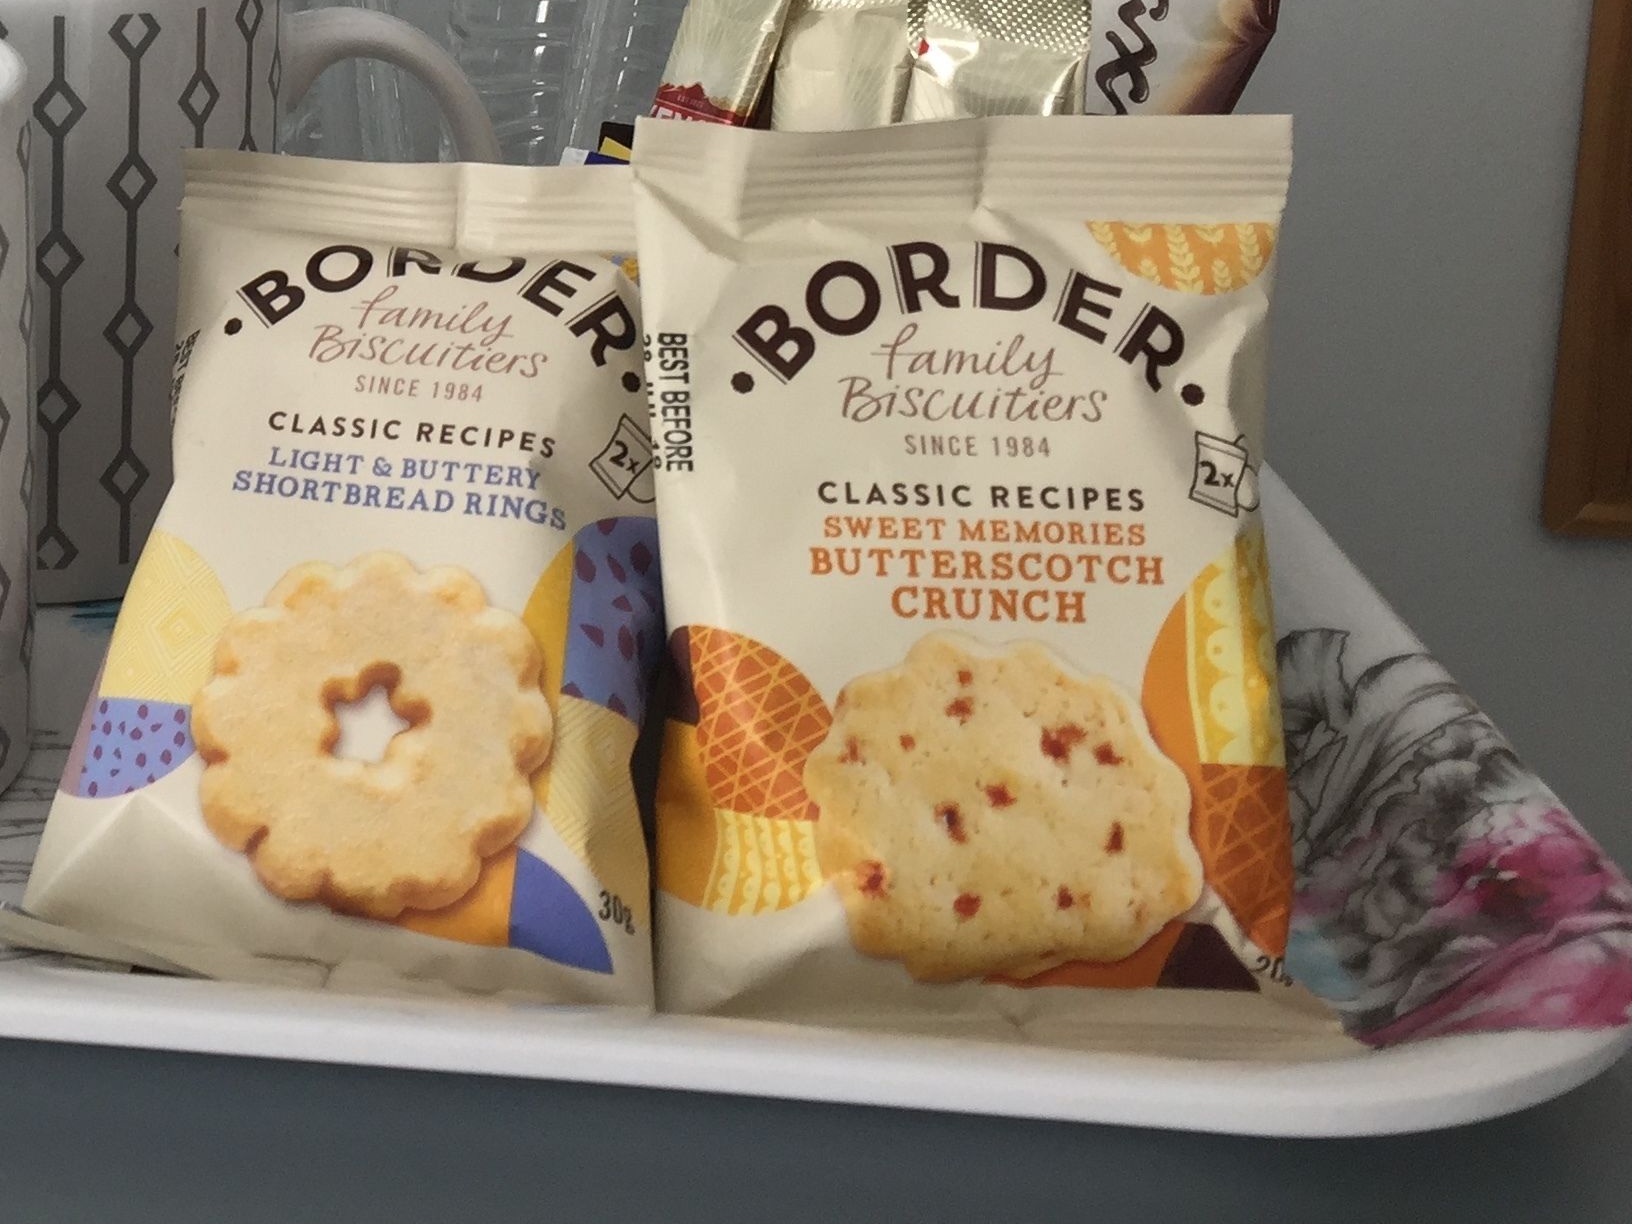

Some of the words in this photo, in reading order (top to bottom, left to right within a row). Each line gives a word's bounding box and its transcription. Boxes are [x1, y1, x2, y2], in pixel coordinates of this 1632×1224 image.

[350, 285, 515, 346] family
[732, 240, 1185, 392] BORDER
[308, 323, 548, 378] Biscuitiers
[657, 332, 690, 385] BEST
[870, 322, 1063, 390] family
[354, 374, 419, 398] SINCE
[432, 380, 485, 403] 1984
[837, 376, 1108, 422] Biscuitiers
[268, 411, 402, 441] CLASSIC
[416, 422, 557, 459] RECIPES
[660, 390, 694, 472] BEFORE
[904, 433, 978, 457] SINCE
[991, 435, 1050, 458] 1984
[268, 446, 364, 476] LIGHT
[372, 457, 393, 478] &
[401, 457, 542, 492] BUTTERY
[1200, 460, 1235, 489] 2x
[231, 469, 455, 514] SHORTBREAD
[464, 491, 568, 532] RINGS
[817, 481, 972, 508] CLASSIC
[990, 485, 1145, 512] RECIPES
[823, 516, 947, 541] SWEET
[958, 518, 1147, 547] MEMORIES
[809, 547, 1165, 586] BUTTERSCOTCH
[890, 586, 1087, 623] CRUNCH
[598, 889, 636, 936] 30g
